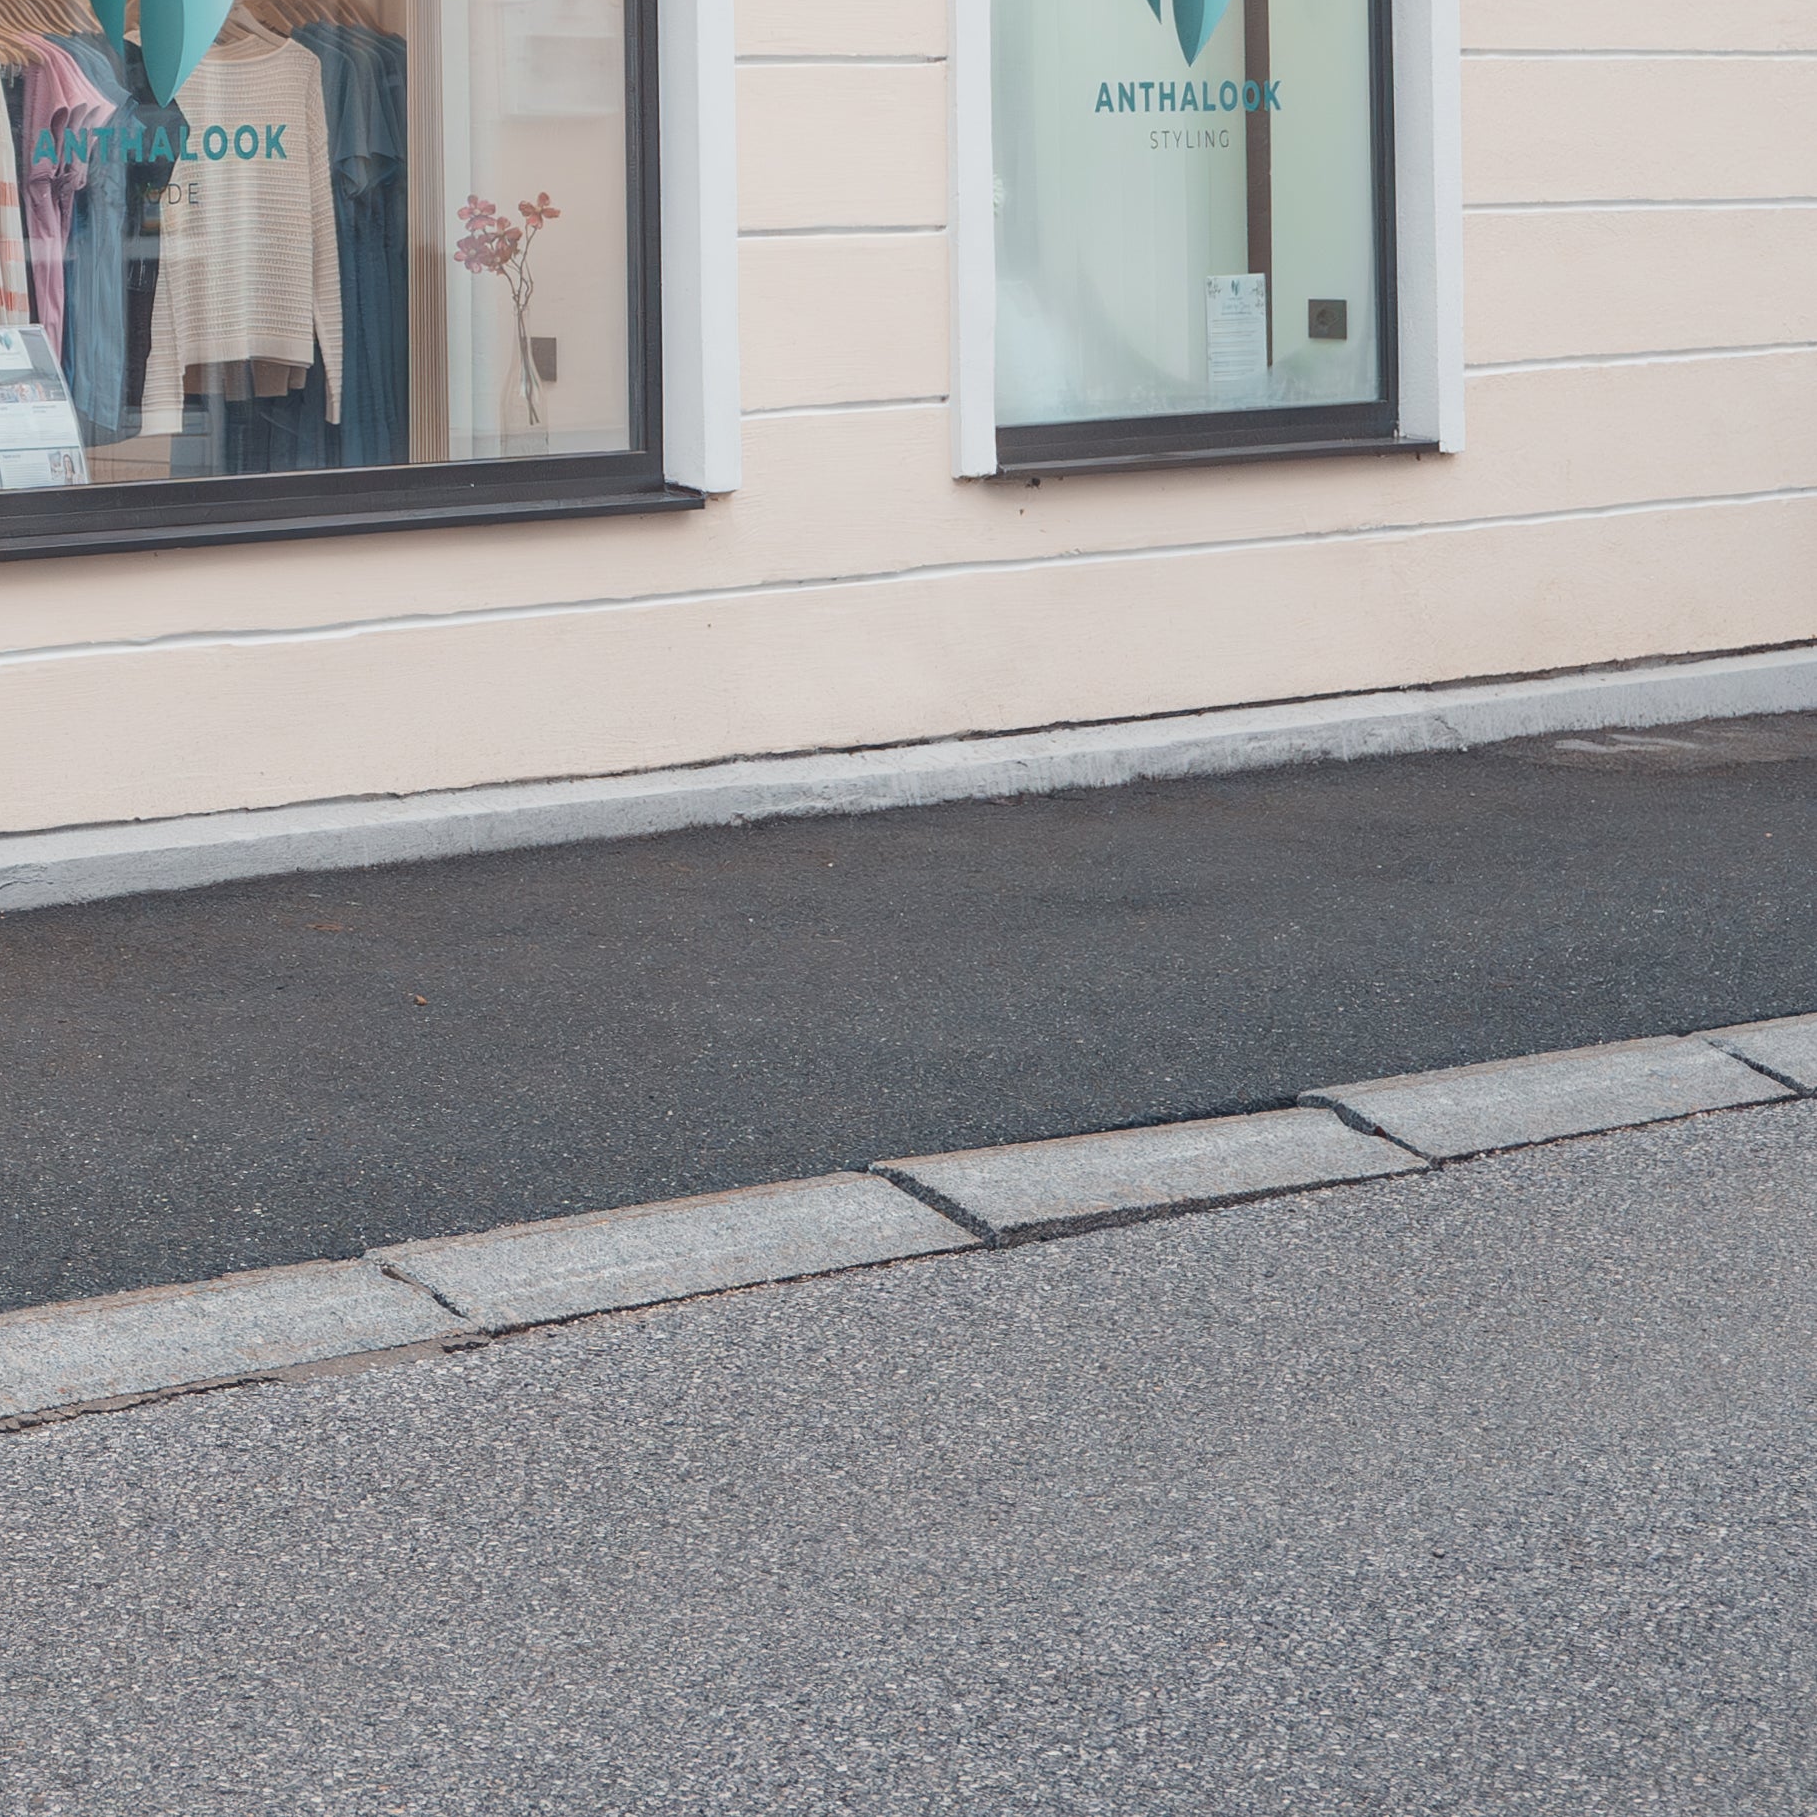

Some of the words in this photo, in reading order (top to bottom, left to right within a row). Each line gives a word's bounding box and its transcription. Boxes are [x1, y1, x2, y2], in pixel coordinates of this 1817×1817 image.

[1095, 80, 1281, 112] ANTHALOOK
[32, 124, 287, 164] ANTHALOOK
[1150, 130, 1229, 149] STYLING
